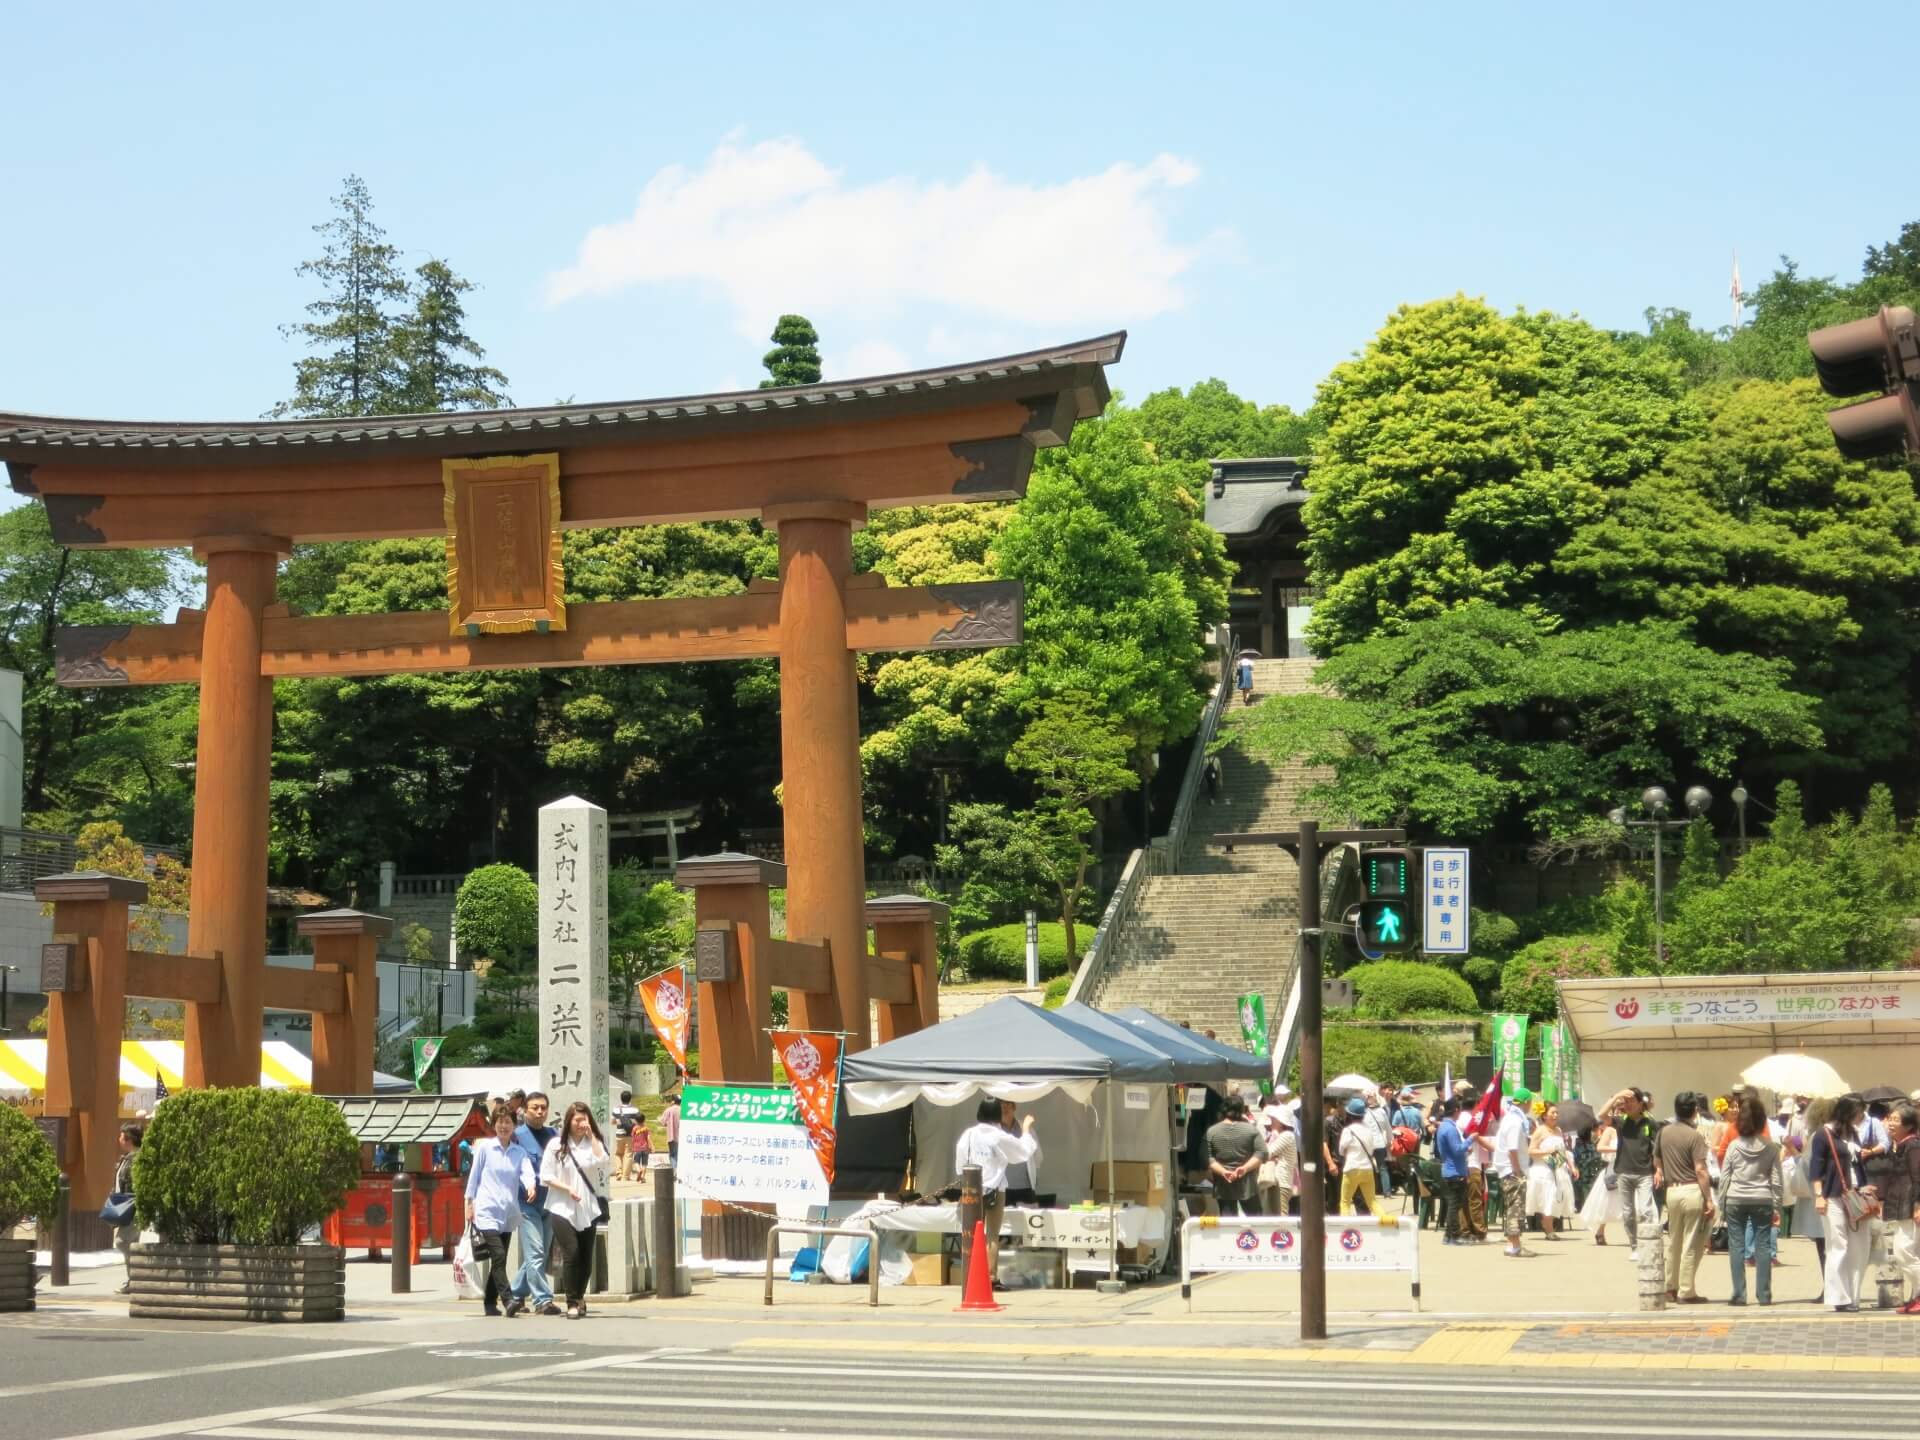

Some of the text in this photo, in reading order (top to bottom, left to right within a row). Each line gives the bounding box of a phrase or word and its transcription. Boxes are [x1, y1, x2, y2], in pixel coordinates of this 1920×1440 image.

[1432, 859, 1445, 907] 自転車
[1447, 859, 1461, 907] 歩行者
[1440, 912, 1452, 943] 専用
[549, 821, 582, 1128] 式内大社二荒山
[1647, 995, 1902, 1016] 手をつなごう 世界のなかま
[686, 1101, 803, 1121] スタンプラリークイ
